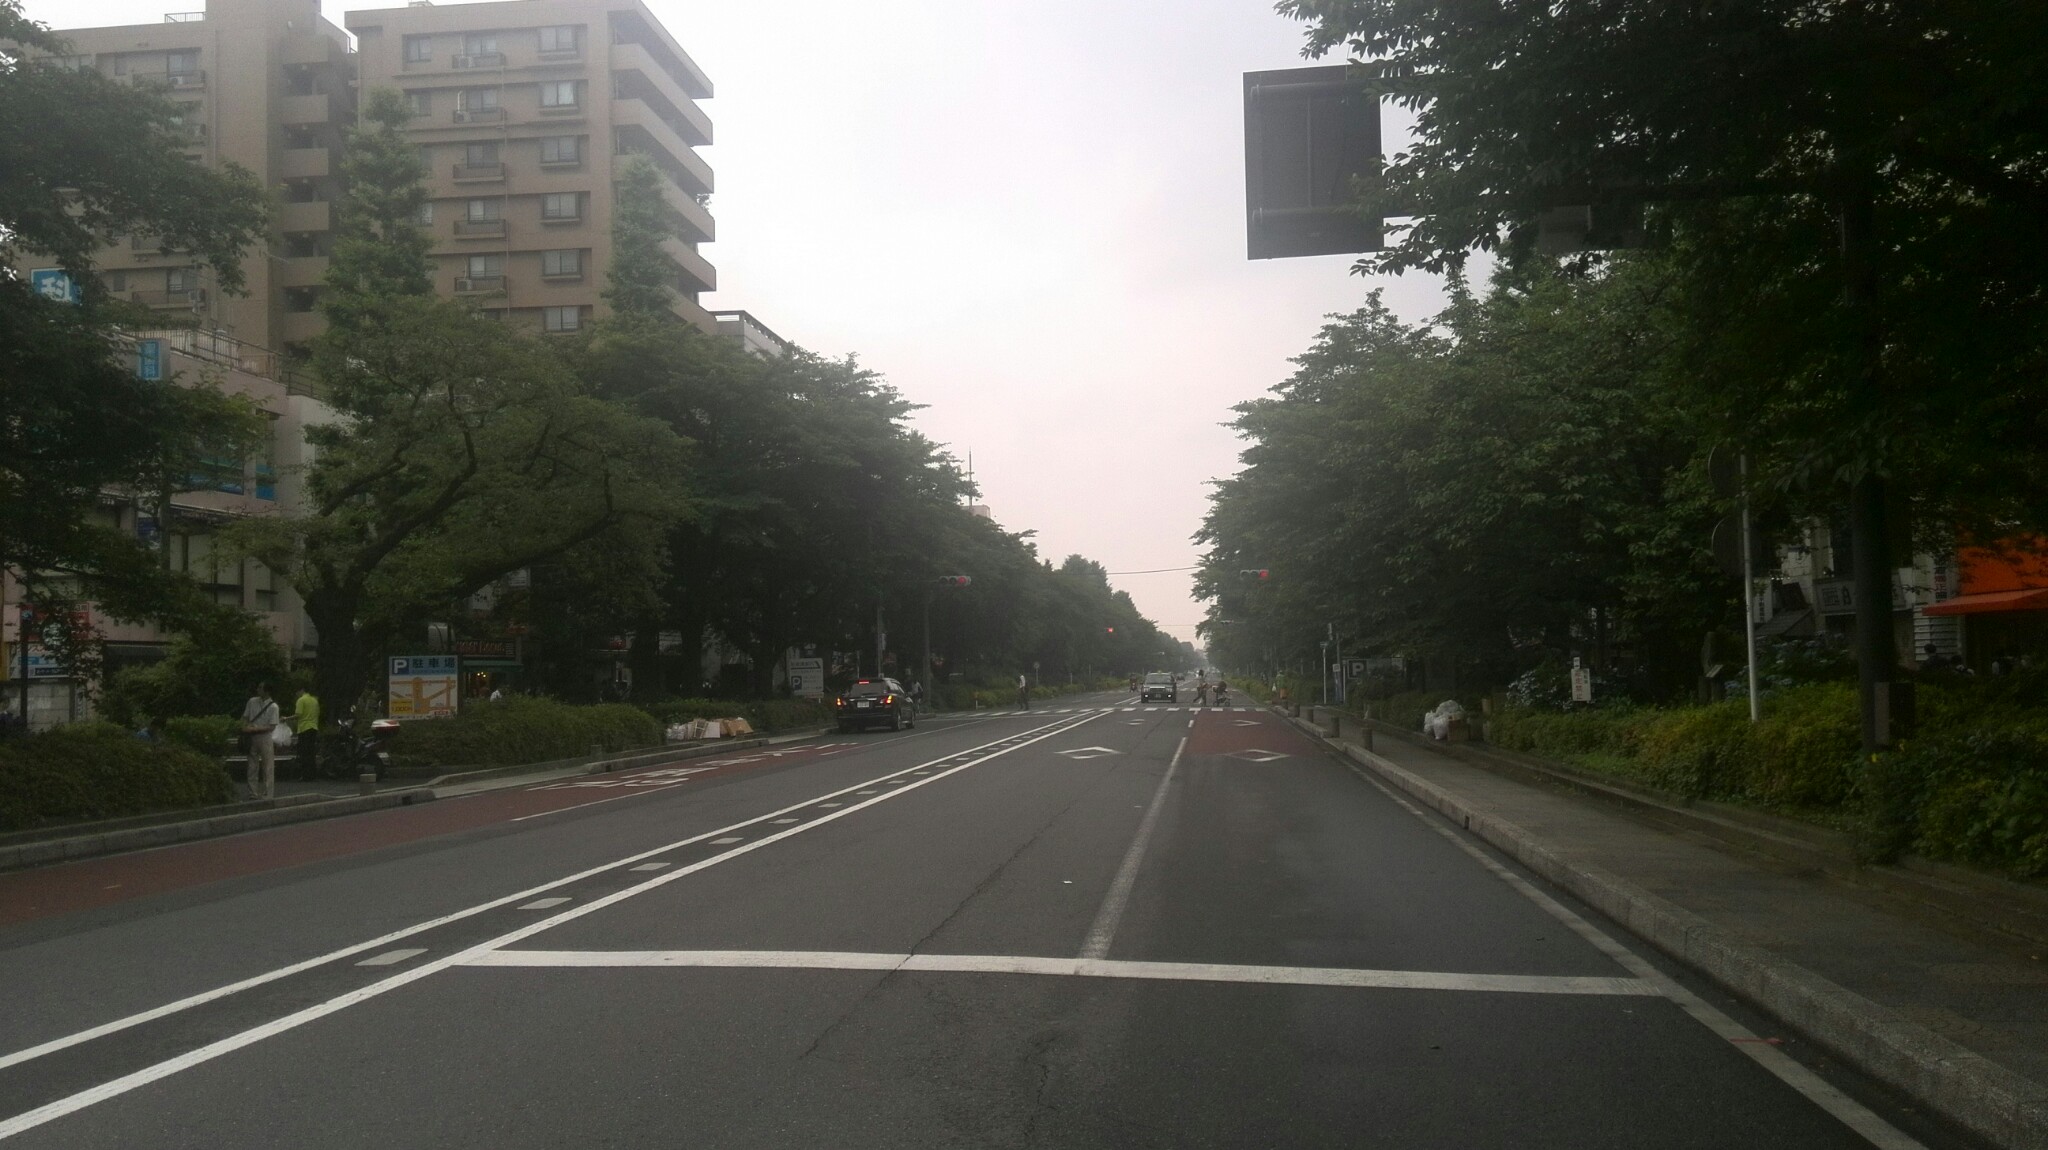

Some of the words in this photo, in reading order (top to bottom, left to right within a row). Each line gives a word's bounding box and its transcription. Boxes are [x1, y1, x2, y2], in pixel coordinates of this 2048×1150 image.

[393, 659, 408, 674] P
[412, 657, 455, 668] 駐車場
[1352, 662, 1365, 676] P
[792, 677, 801, 689] P
